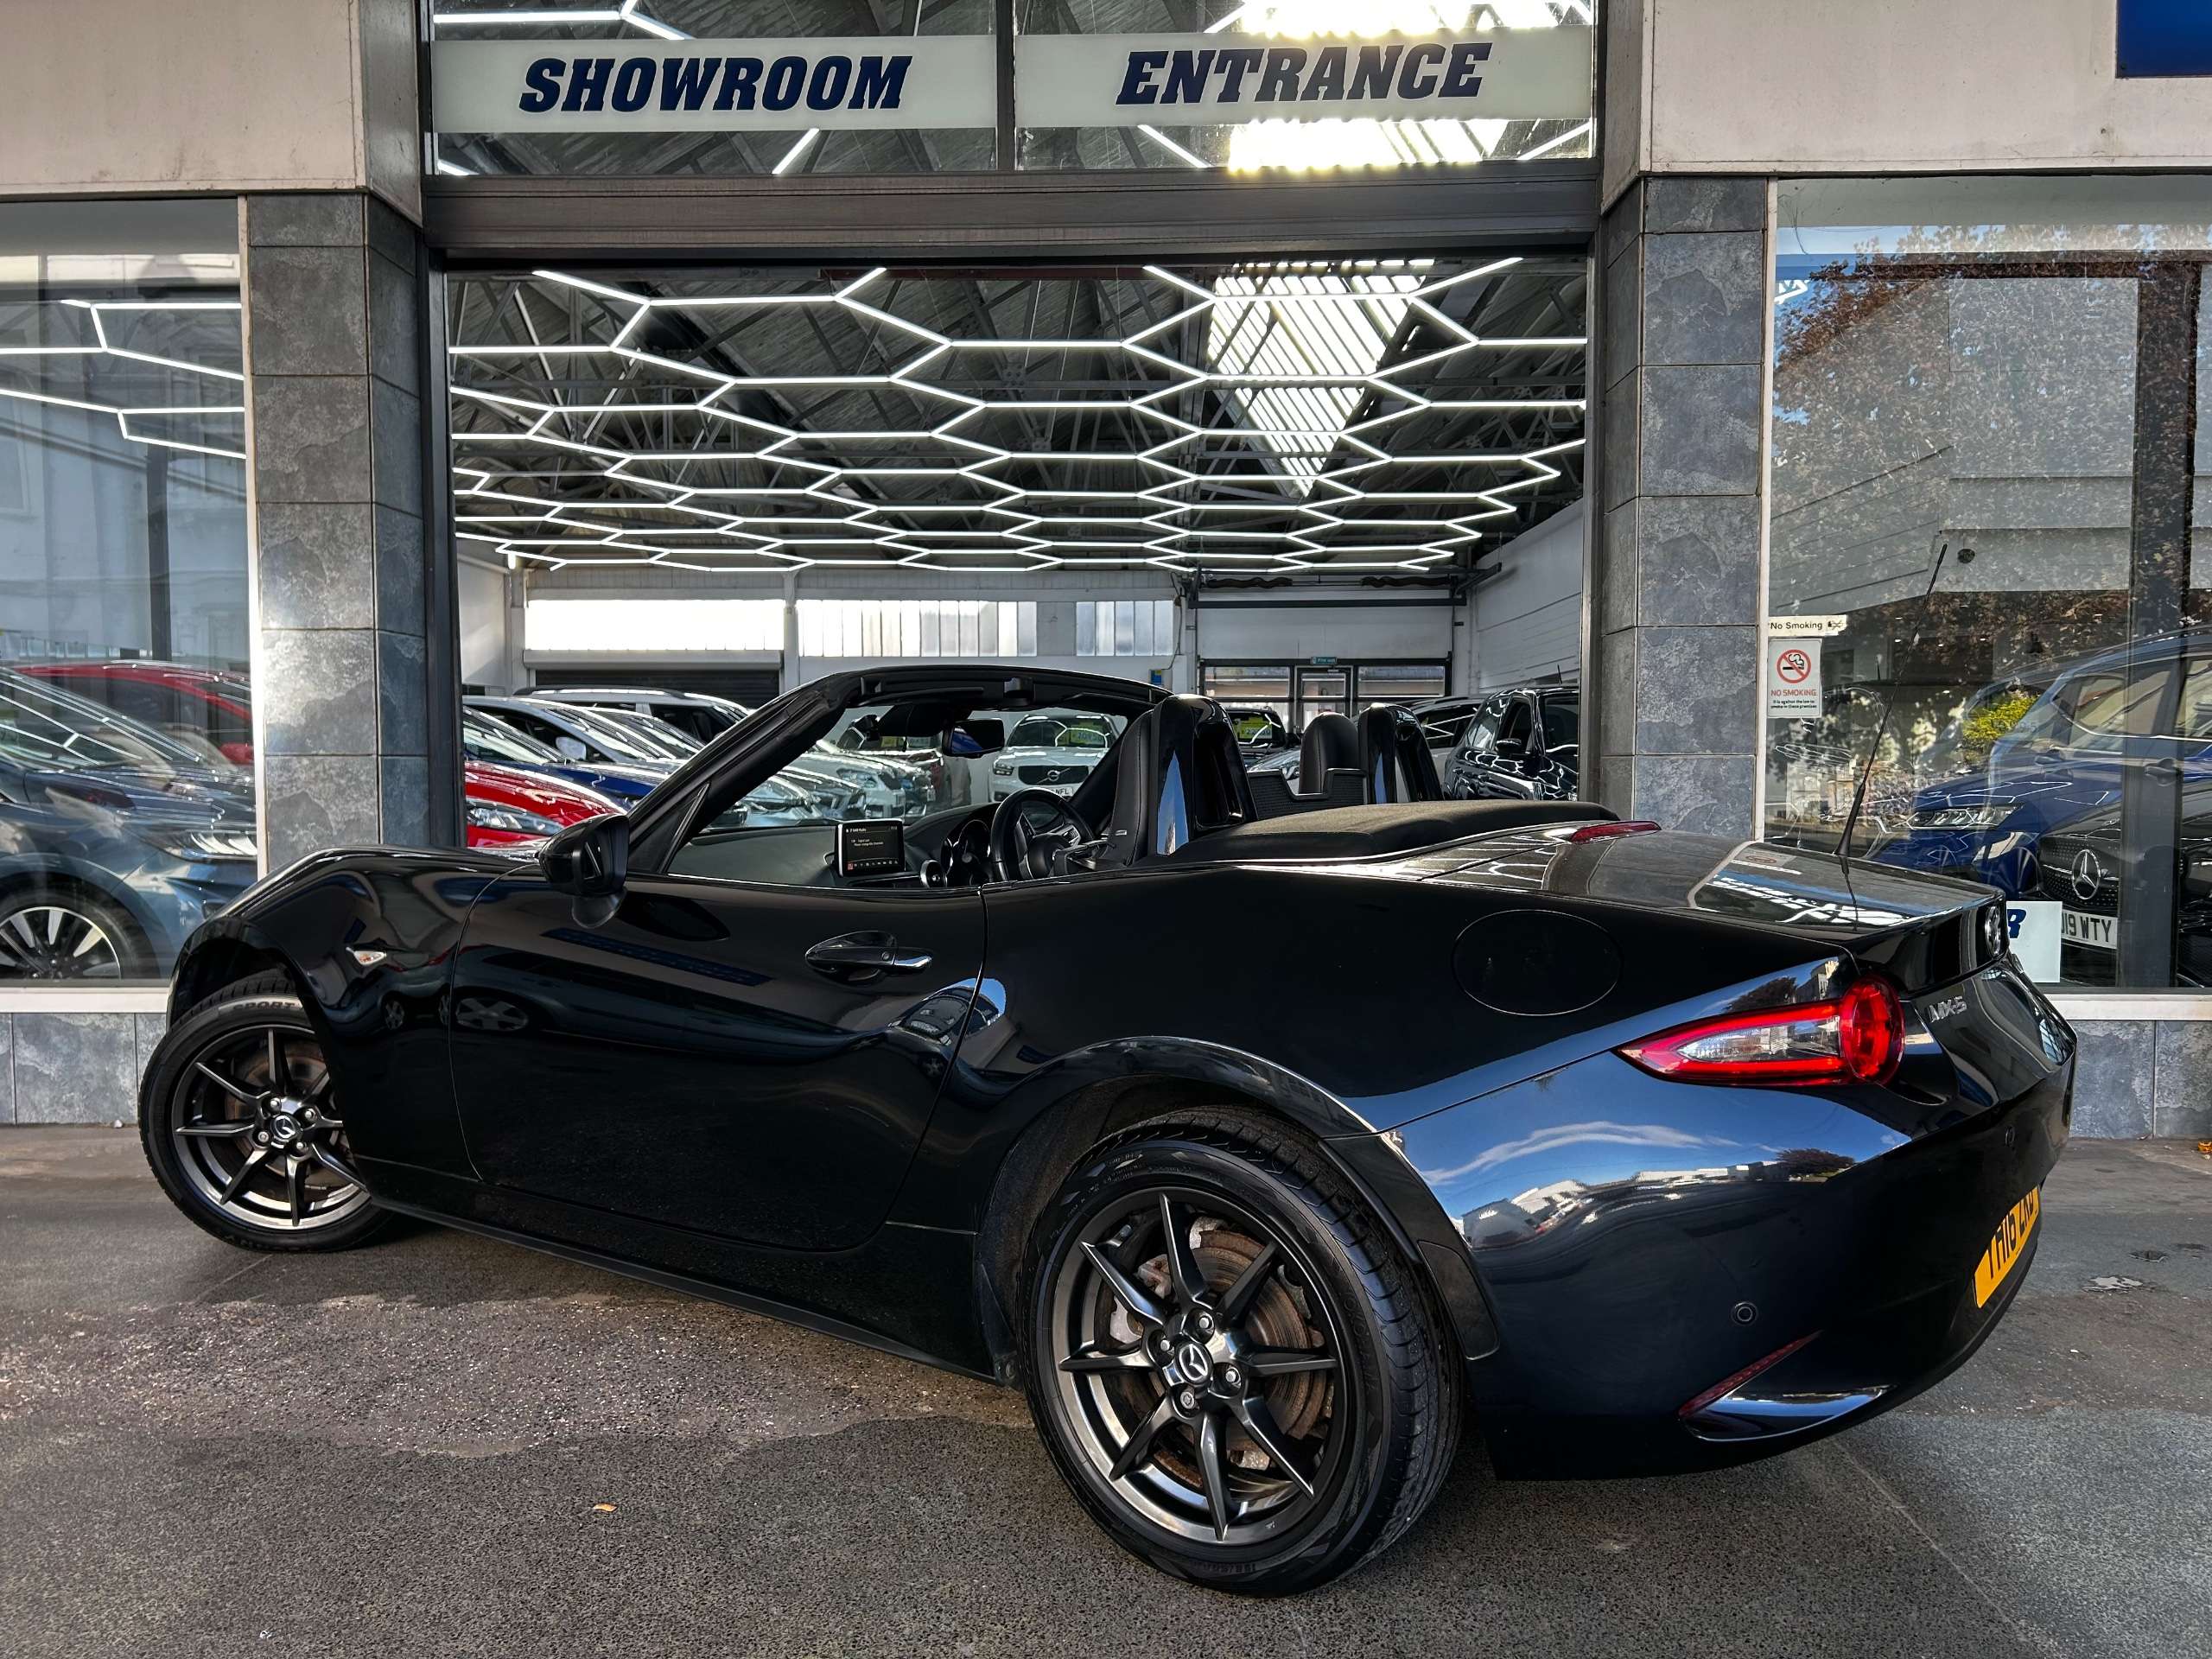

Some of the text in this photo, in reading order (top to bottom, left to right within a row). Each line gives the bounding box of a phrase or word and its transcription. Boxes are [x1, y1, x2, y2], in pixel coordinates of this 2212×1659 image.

[518, 42, 1493, 112] SHOWROOM ENTRANCE
[1785, 621, 1822, 630] Smoking
[2081, 916, 2112, 943] WTY
[1928, 995, 1967, 1023] MX-5
